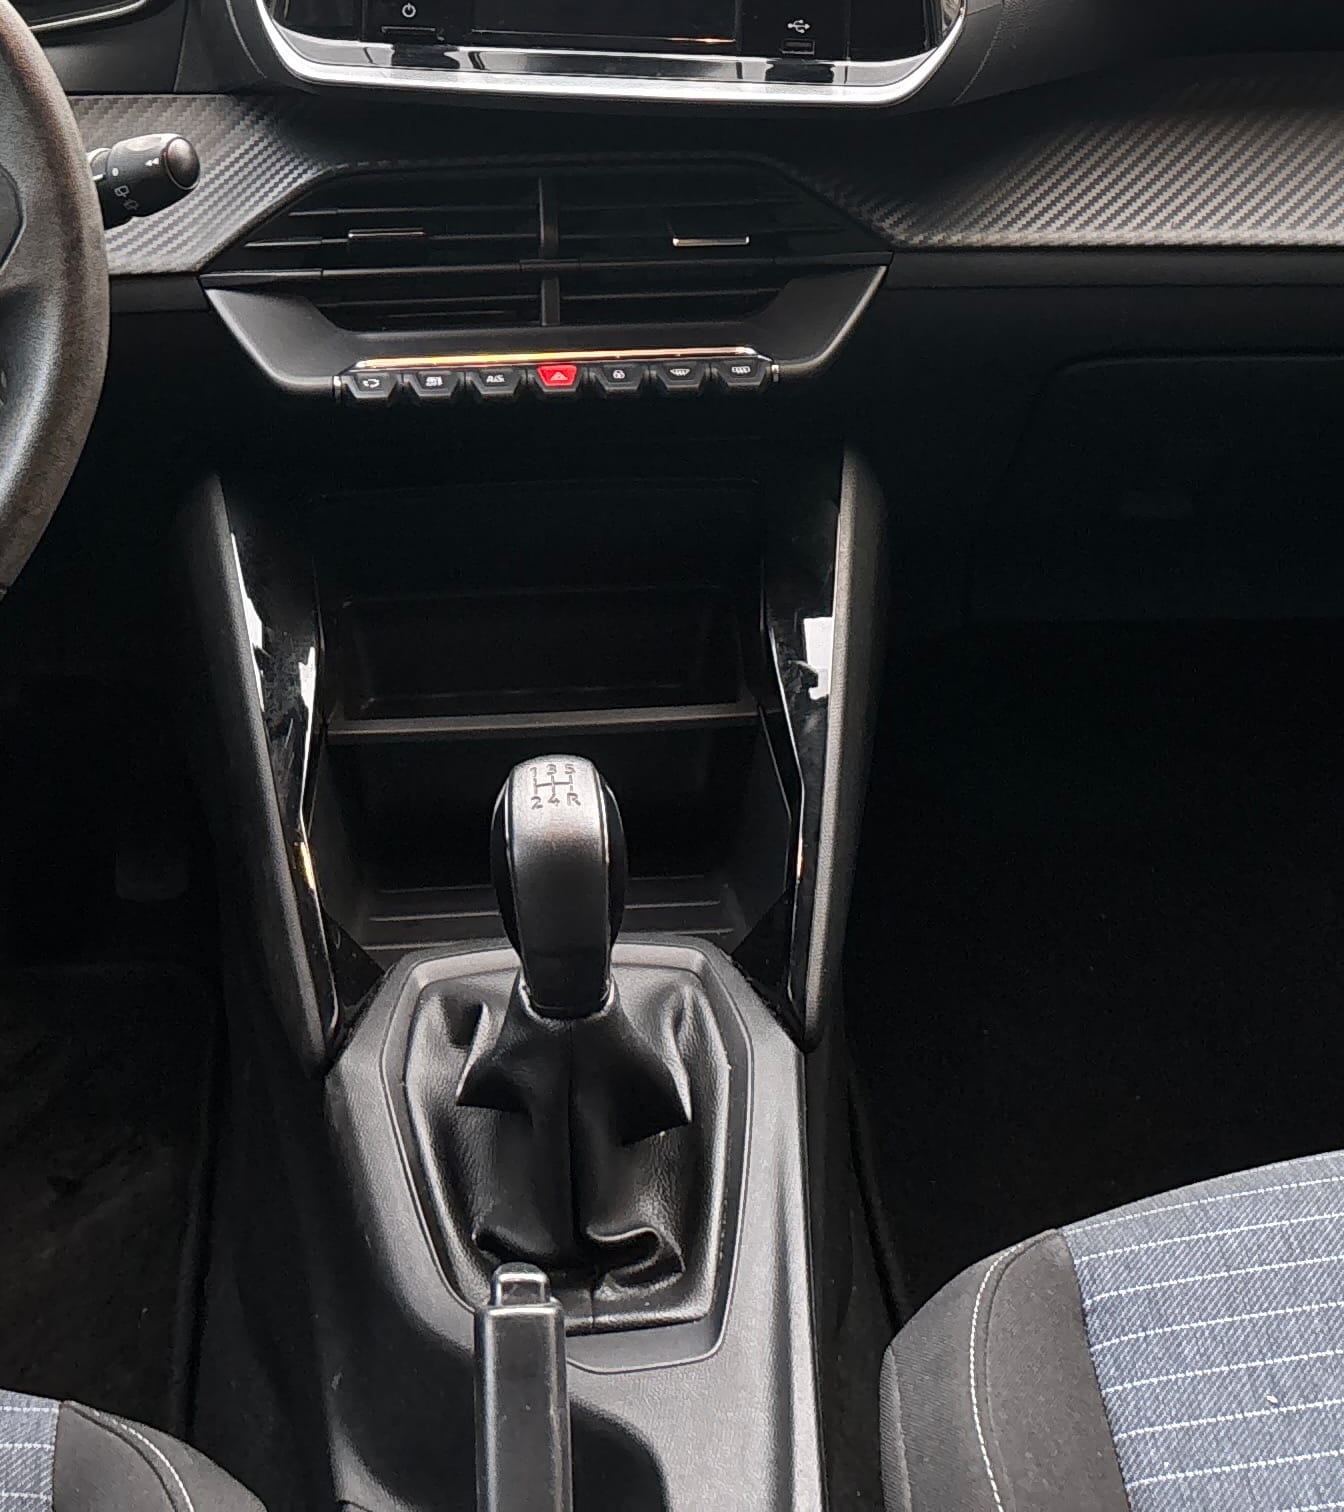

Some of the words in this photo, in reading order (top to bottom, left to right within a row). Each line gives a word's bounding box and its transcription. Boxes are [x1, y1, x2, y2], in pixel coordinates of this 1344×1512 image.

[530, 766, 537, 777] 1
[546, 763, 557, 775] 3
[565, 763, 576, 774] 5
[531, 796, 543, 809] 2
[547, 793, 560, 806] 4
[567, 792, 581, 806] R
